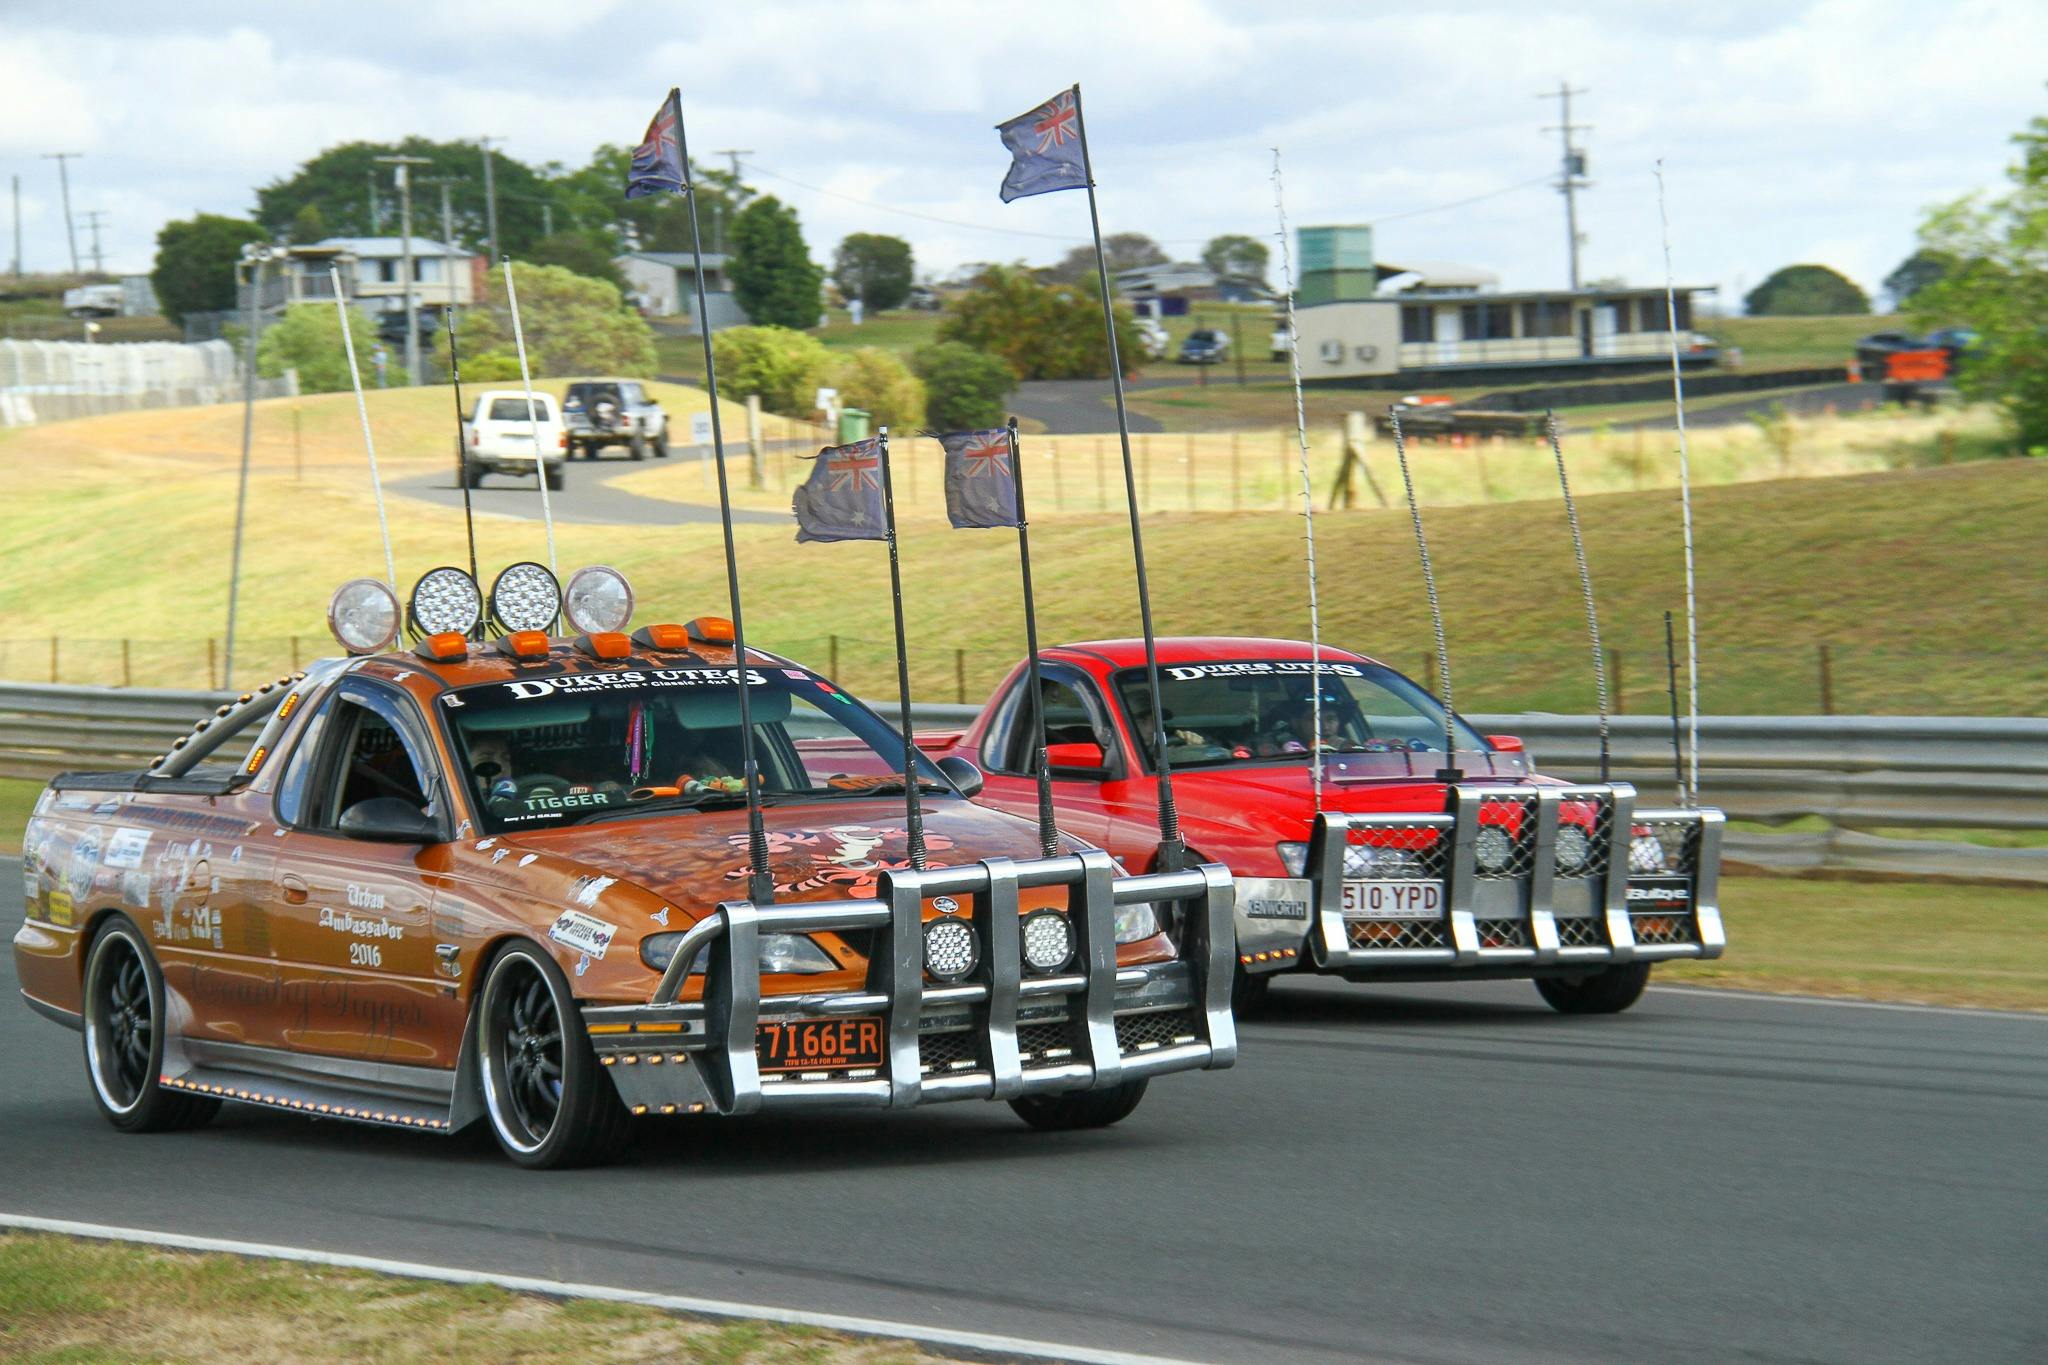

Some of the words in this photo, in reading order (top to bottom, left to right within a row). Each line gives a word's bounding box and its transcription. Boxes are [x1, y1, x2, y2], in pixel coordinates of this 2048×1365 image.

[503, 671, 645, 700] DUKES
[652, 668, 768, 686] UTES
[524, 793, 609, 810] TIGGER
[347, 884, 385, 910] Urban
[1248, 899, 1306, 917] KENWORTH
[319, 907, 403, 940] Ambassador
[350, 942, 382, 968] 2016
